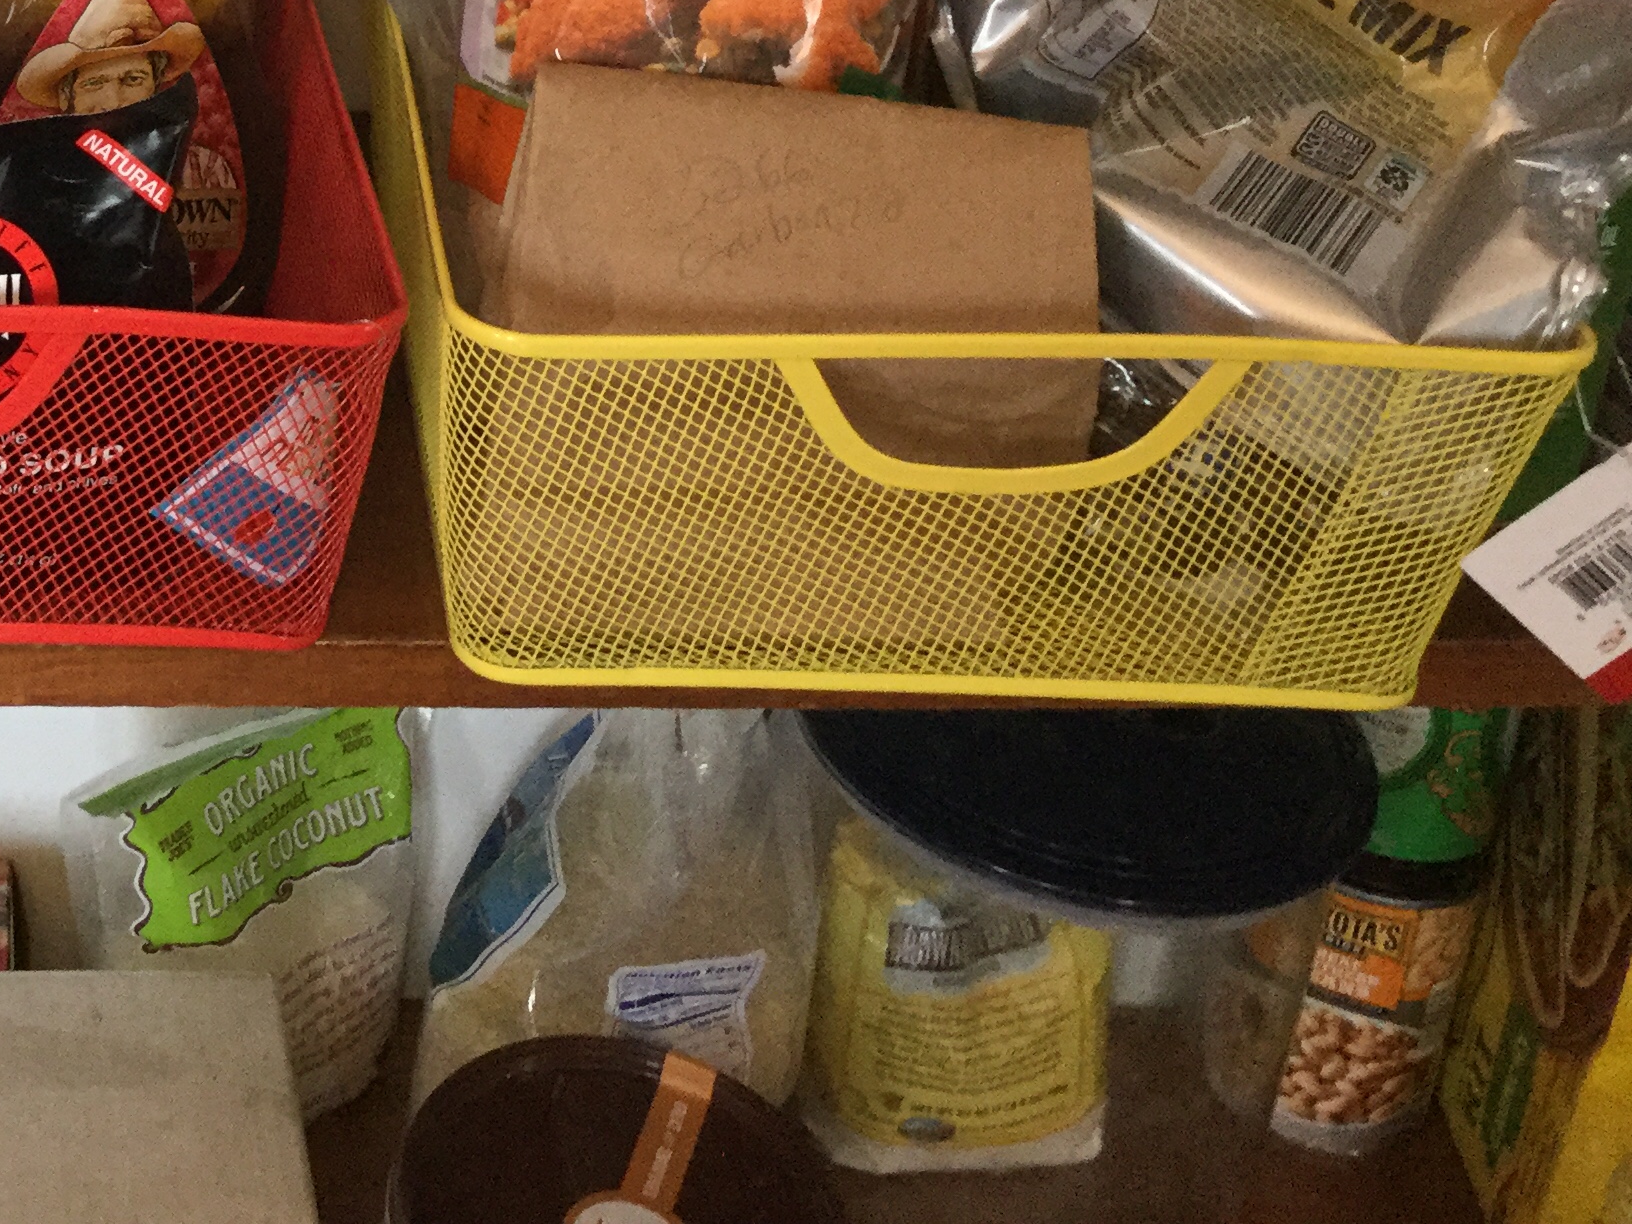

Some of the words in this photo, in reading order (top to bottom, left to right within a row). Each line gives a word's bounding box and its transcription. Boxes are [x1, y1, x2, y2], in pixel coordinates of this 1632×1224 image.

[82, 133, 167, 208] NATURAL
[20, 444, 125, 476] SOUP
[202, 742, 319, 837] ORGANIC
[187, 849, 266, 927] FLAKE
[266, 784, 386, 871] COCONUT
